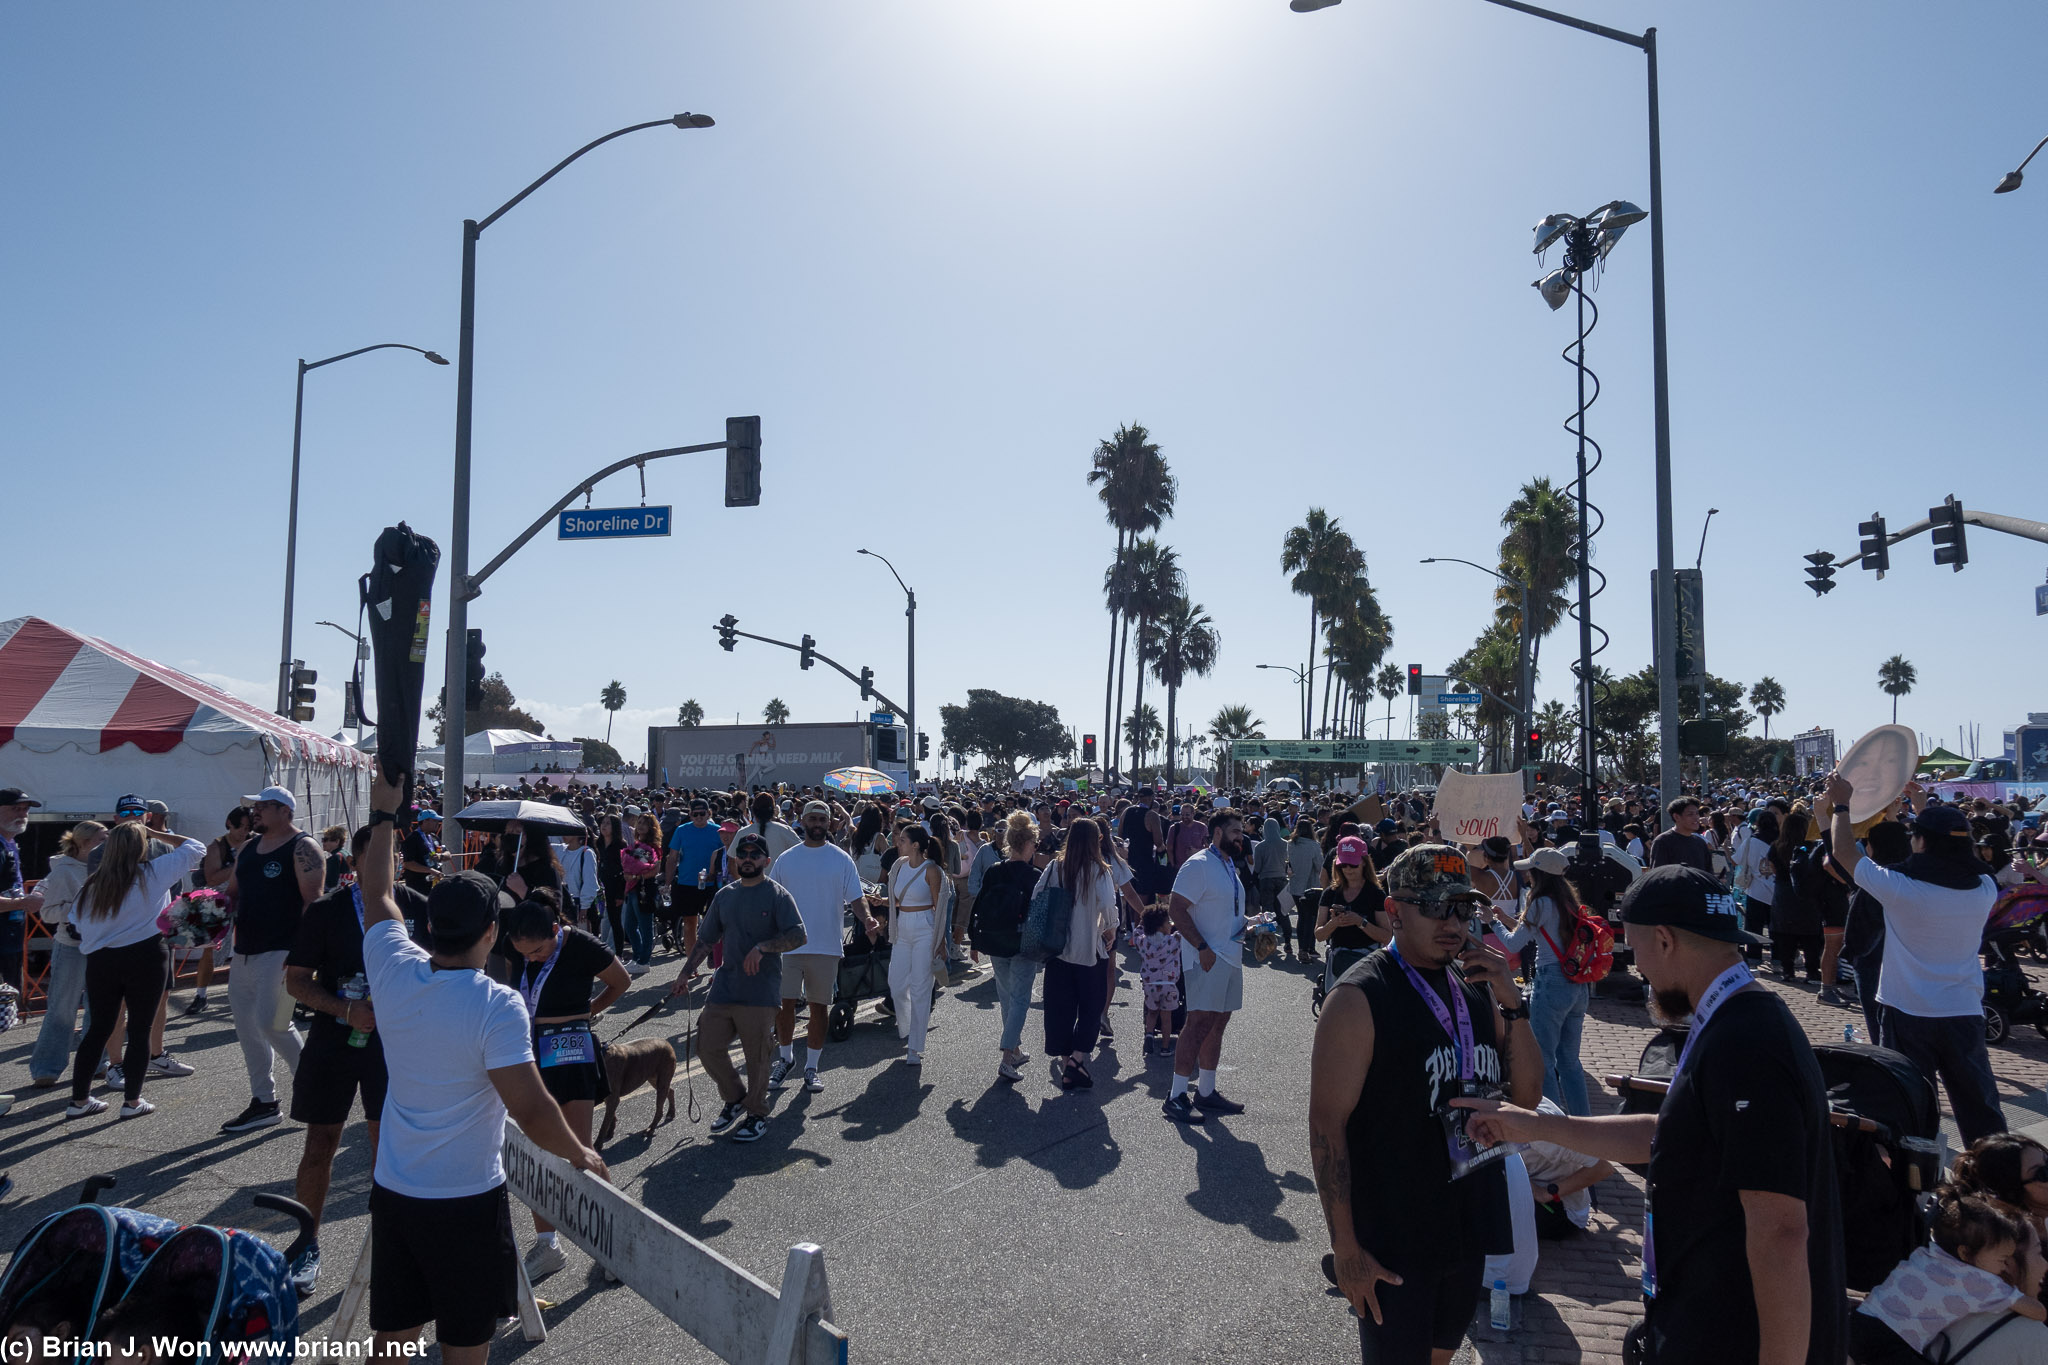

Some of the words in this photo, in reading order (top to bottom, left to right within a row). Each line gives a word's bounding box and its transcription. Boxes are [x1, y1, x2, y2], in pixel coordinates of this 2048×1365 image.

[565, 515, 639, 533] Shoreline
[644, 514, 664, 529] Dr
[1440, 695, 1470, 703] Shoreline
[1471, 695, 1480, 703] Dr
[680, 754, 725, 765] YOU'RE
[727, 753, 774, 765] GNNA
[775, 752, 809, 764] NEED
[809, 751, 844, 764] MILK
[679, 766, 703, 777] FOR
[1455, 816, 1499, 838] YOUR
[551, 1035, 585, 1050] 3262
